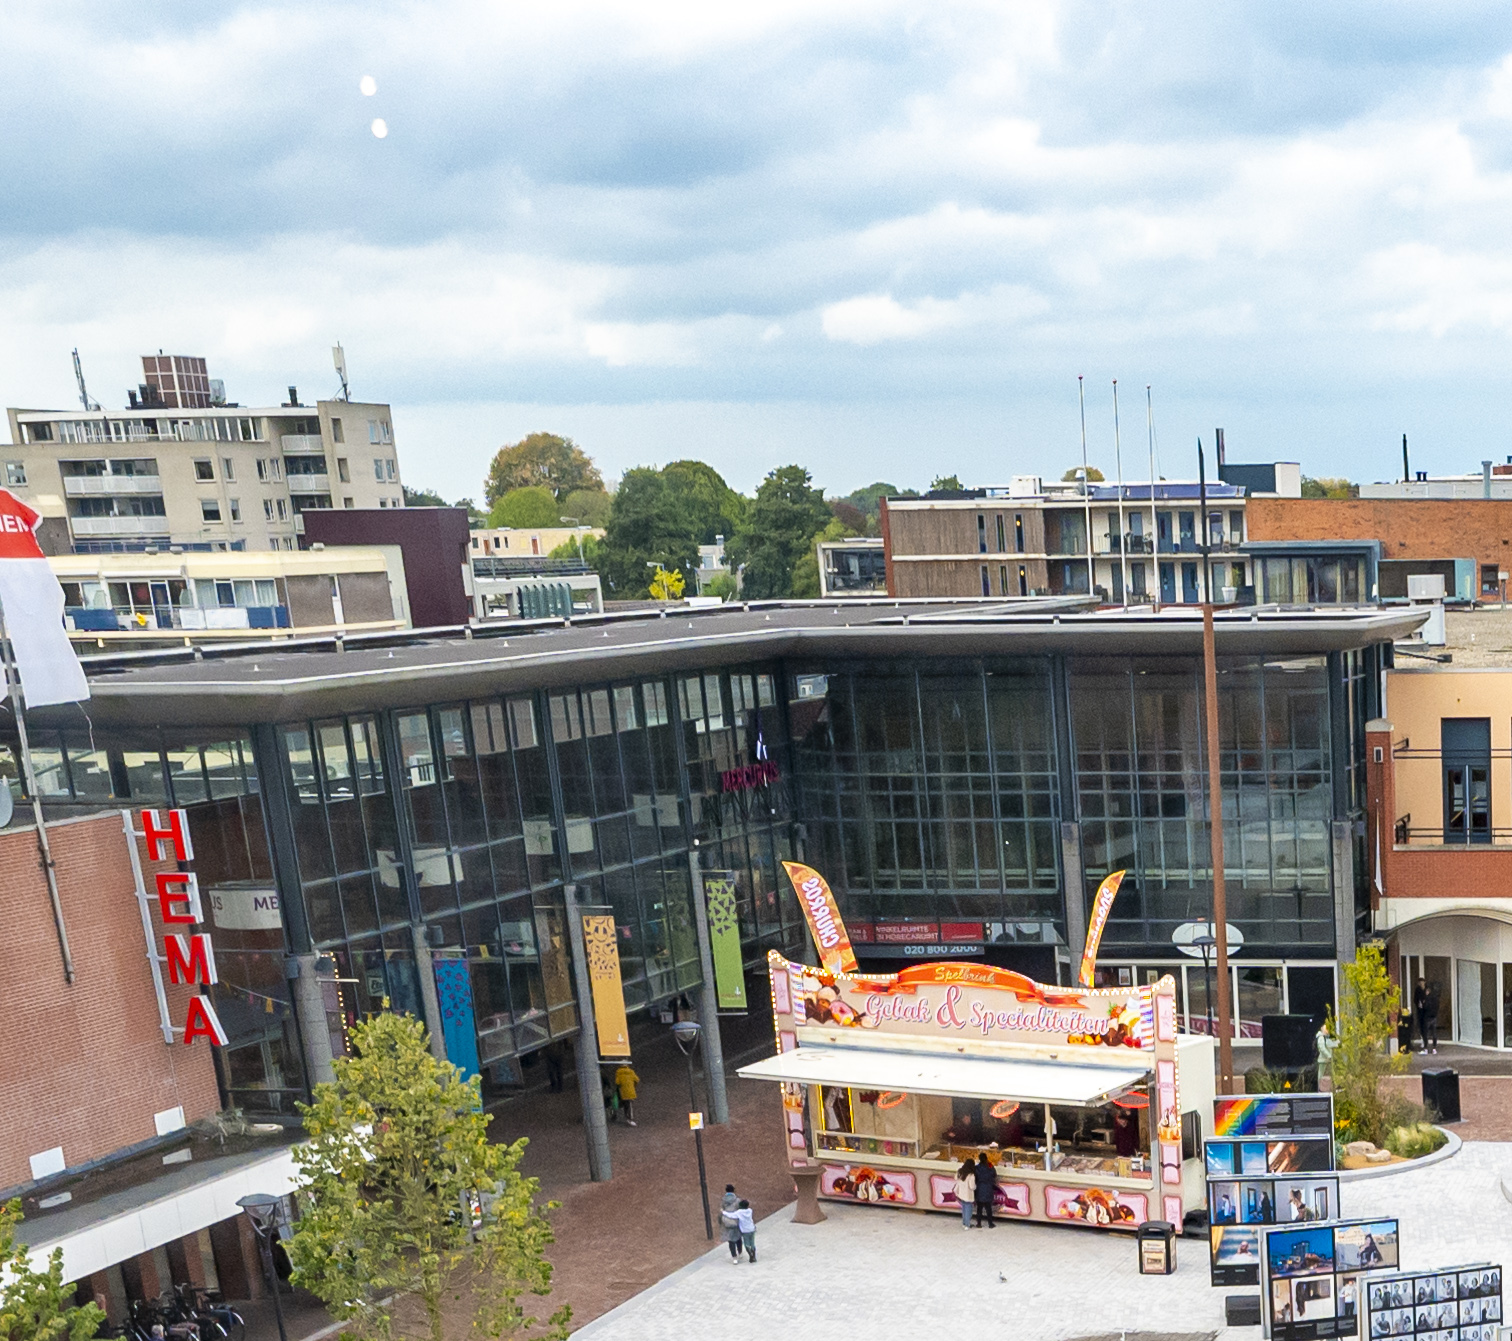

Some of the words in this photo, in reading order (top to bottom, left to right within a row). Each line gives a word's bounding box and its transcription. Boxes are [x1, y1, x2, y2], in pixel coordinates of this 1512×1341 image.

[141, 809, 229, 1046] HEMA
[904, 945, 925, 955] 020
[934, 966, 995, 984] Spelbrink
[865, 993, 932, 1027] Gebak
[937, 985, 966, 1028] &
[969, 1001, 1110, 1035] Specialiteiten
